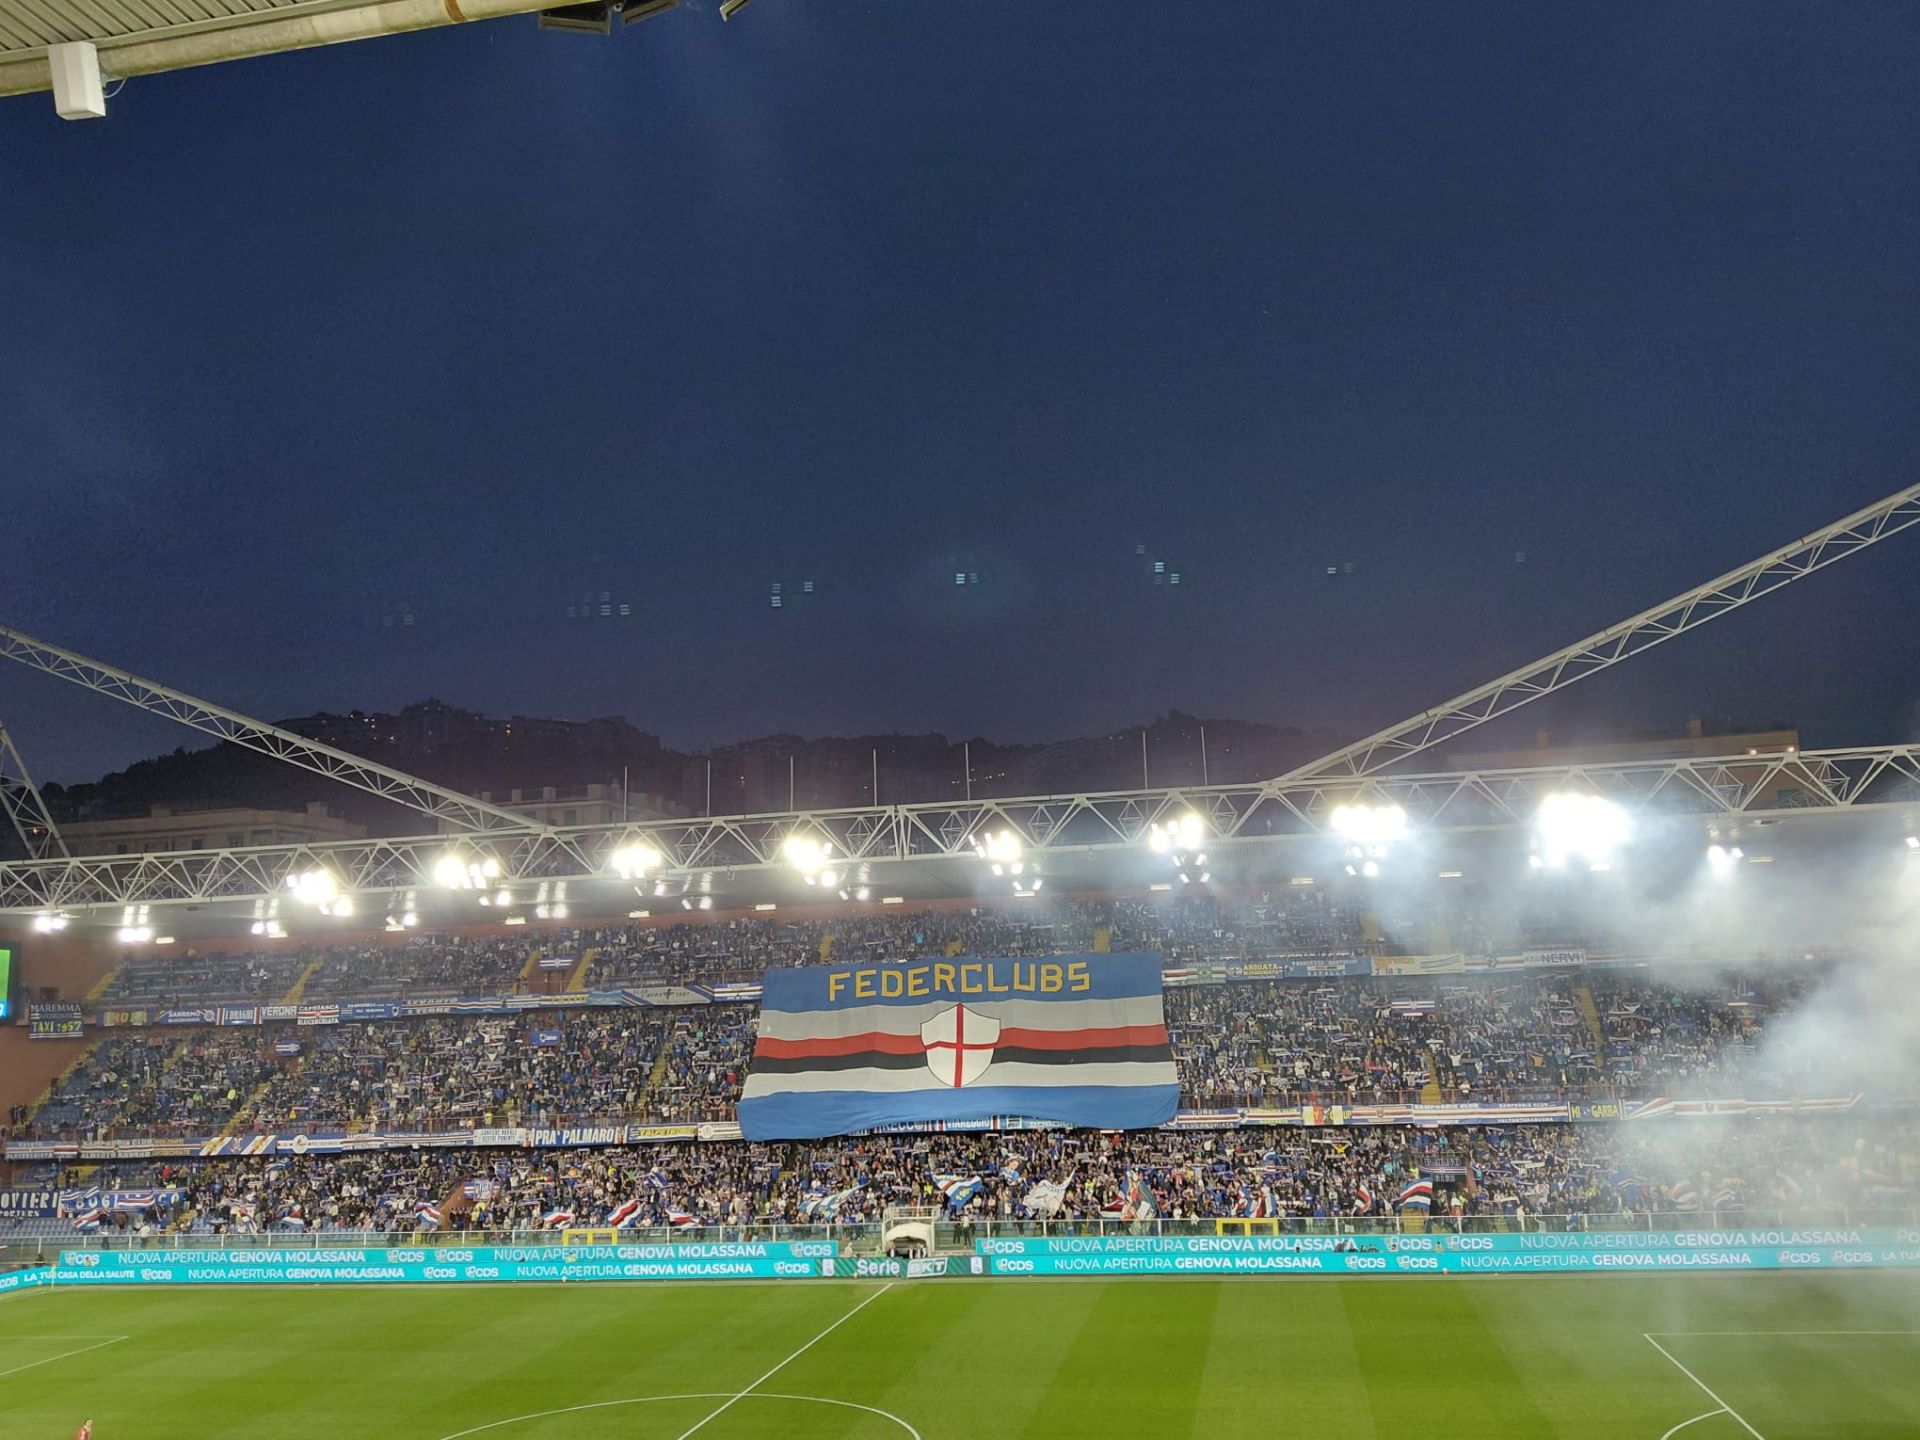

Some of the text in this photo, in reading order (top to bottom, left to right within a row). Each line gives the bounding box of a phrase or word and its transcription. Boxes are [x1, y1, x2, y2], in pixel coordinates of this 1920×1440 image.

[829, 962, 1090, 1002] FEDERCLUBS
[30, 1003, 81, 1013] MAREMMA
[262, 1005, 297, 1016] VERONA
[32, 1021, 54, 1032] TAXI
[1591, 1104, 1619, 1117] GARBA
[563, 1128, 614, 1144] PALMARO
[1049, 1239, 1101, 1252] NUOVA
[1105, 1238, 1185, 1252] APERTURA
[1188, 1238, 1254, 1251] GENOVA
[1400, 1238, 1432, 1250] CDS
[1460, 1237, 1493, 1250] CDS
[1520, 1231, 1861, 1249] NUOVA APERTURA GENOVA MOLASSANA
[494, 1244, 767, 1261] NUOVA APERTURA GENOVA MOLASSANA
[803, 1243, 832, 1255] CDS
[995, 1241, 1024, 1254] CDS
[118, 1250, 366, 1264] NUOVA APERTURA GENOVA MOLASSANA
[398, 1250, 425, 1262] CDS
[446, 1249, 473, 1262] CDS
[1461, 1253, 1751, 1268] NUOVA APERTURA GENOVA MOLASSANA
[1790, 1252, 1820, 1263] CDS
[1843, 1251, 1873, 1263] CDS
[1882, 1251, 1896, 1261] LA
[785, 1263, 810, 1273] CDS
[857, 1259, 944, 1275] Serie BKT
[1008, 1260, 1034, 1271] CDS
[1055, 1257, 1322, 1270] NUOVA APERTURA GENOVA MOLASSANA
[1358, 1257, 1386, 1268] CDS
[1410, 1257, 1438, 1268] CDS
[24, 1273, 37, 1282] LA
[58, 1271, 78, 1279] CASA
[80, 1270, 105, 1279] DELLA
[105, 1270, 135, 1279] SALUTE
[150, 1270, 172, 1280] CDS
[188, 1267, 405, 1279] NUOVA APERTURA GENOVA MOLASSANA
[433, 1268, 456, 1278] CDS
[476, 1267, 499, 1278] CDS
[517, 1263, 753, 1277] NUOVA APERTURA GENOVA MOLASSANA
